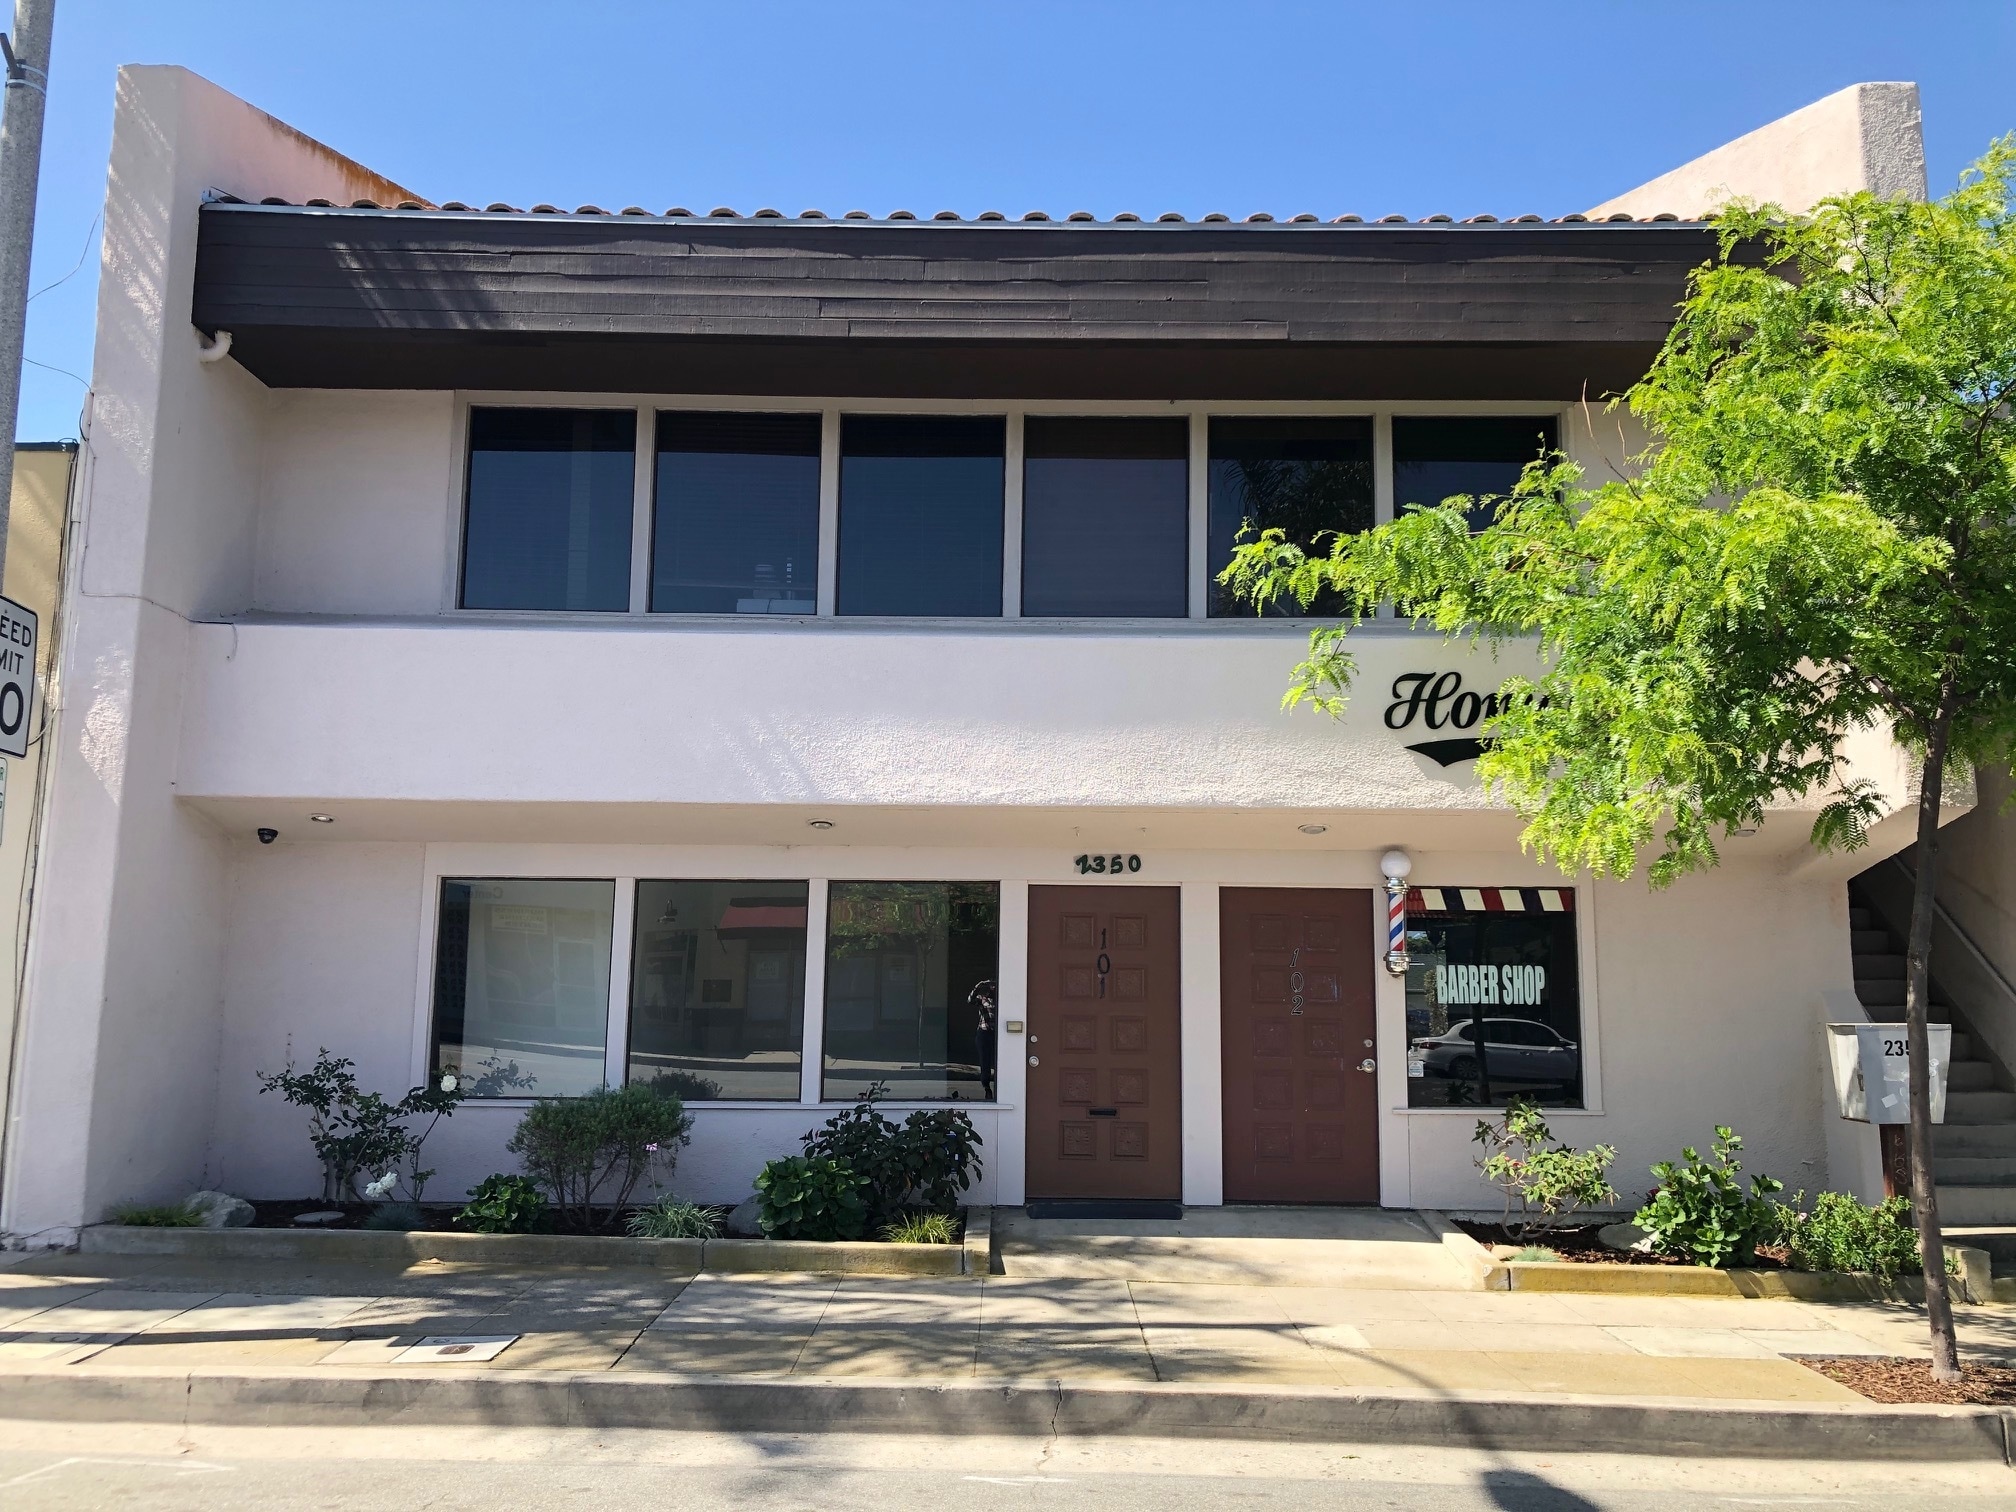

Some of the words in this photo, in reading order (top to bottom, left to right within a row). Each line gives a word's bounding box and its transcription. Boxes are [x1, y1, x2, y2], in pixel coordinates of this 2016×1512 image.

[1075, 854, 1141, 875] 2350
[1097, 928, 1110, 999] 101
[1290, 947, 1304, 1016] 102
[1436, 964, 1499, 1005] BARBER
[1502, 964, 1546, 1006] SHOP
